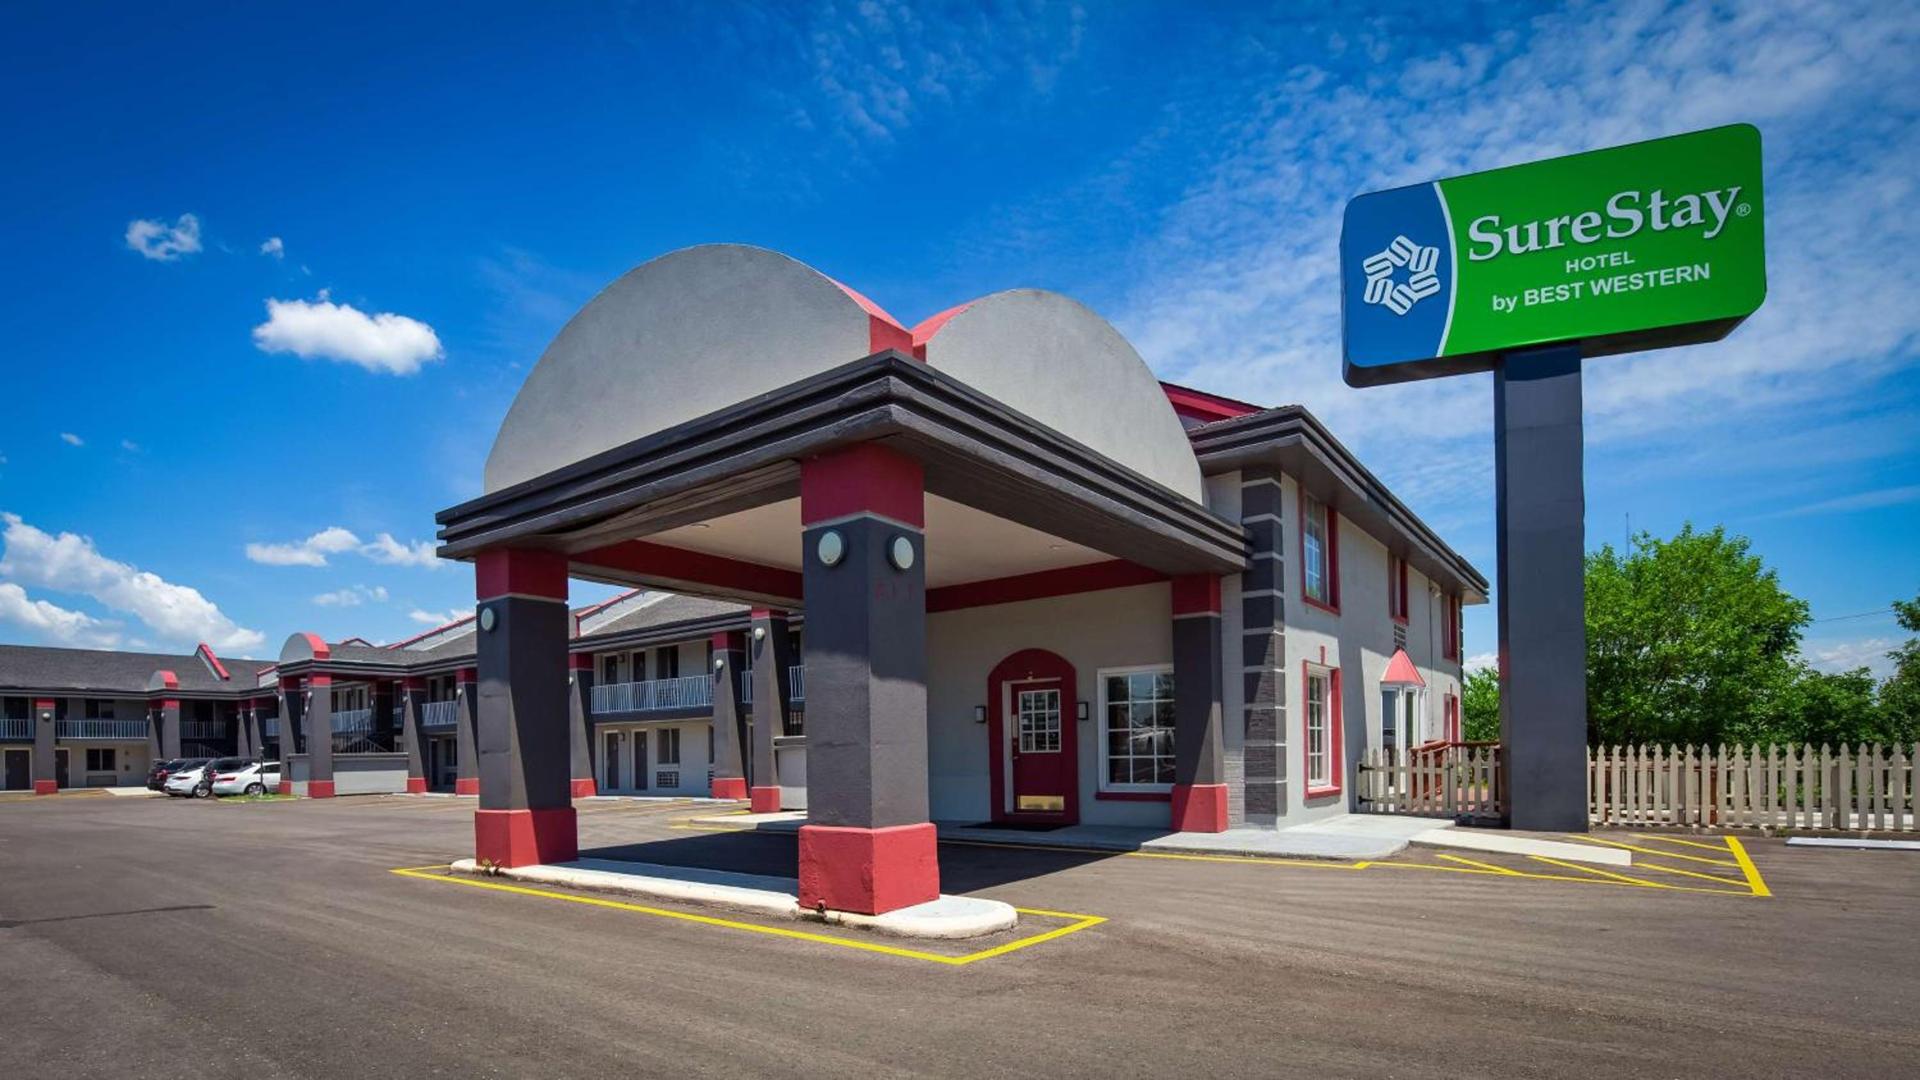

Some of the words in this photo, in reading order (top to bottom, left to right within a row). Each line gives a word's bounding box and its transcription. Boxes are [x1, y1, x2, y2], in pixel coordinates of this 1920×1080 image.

[1566, 251, 1635, 273] HOTEL
[1492, 295, 1518, 313] by
[1523, 282, 1584, 306] BEST
[1590, 262, 1710, 296] WESTERN
